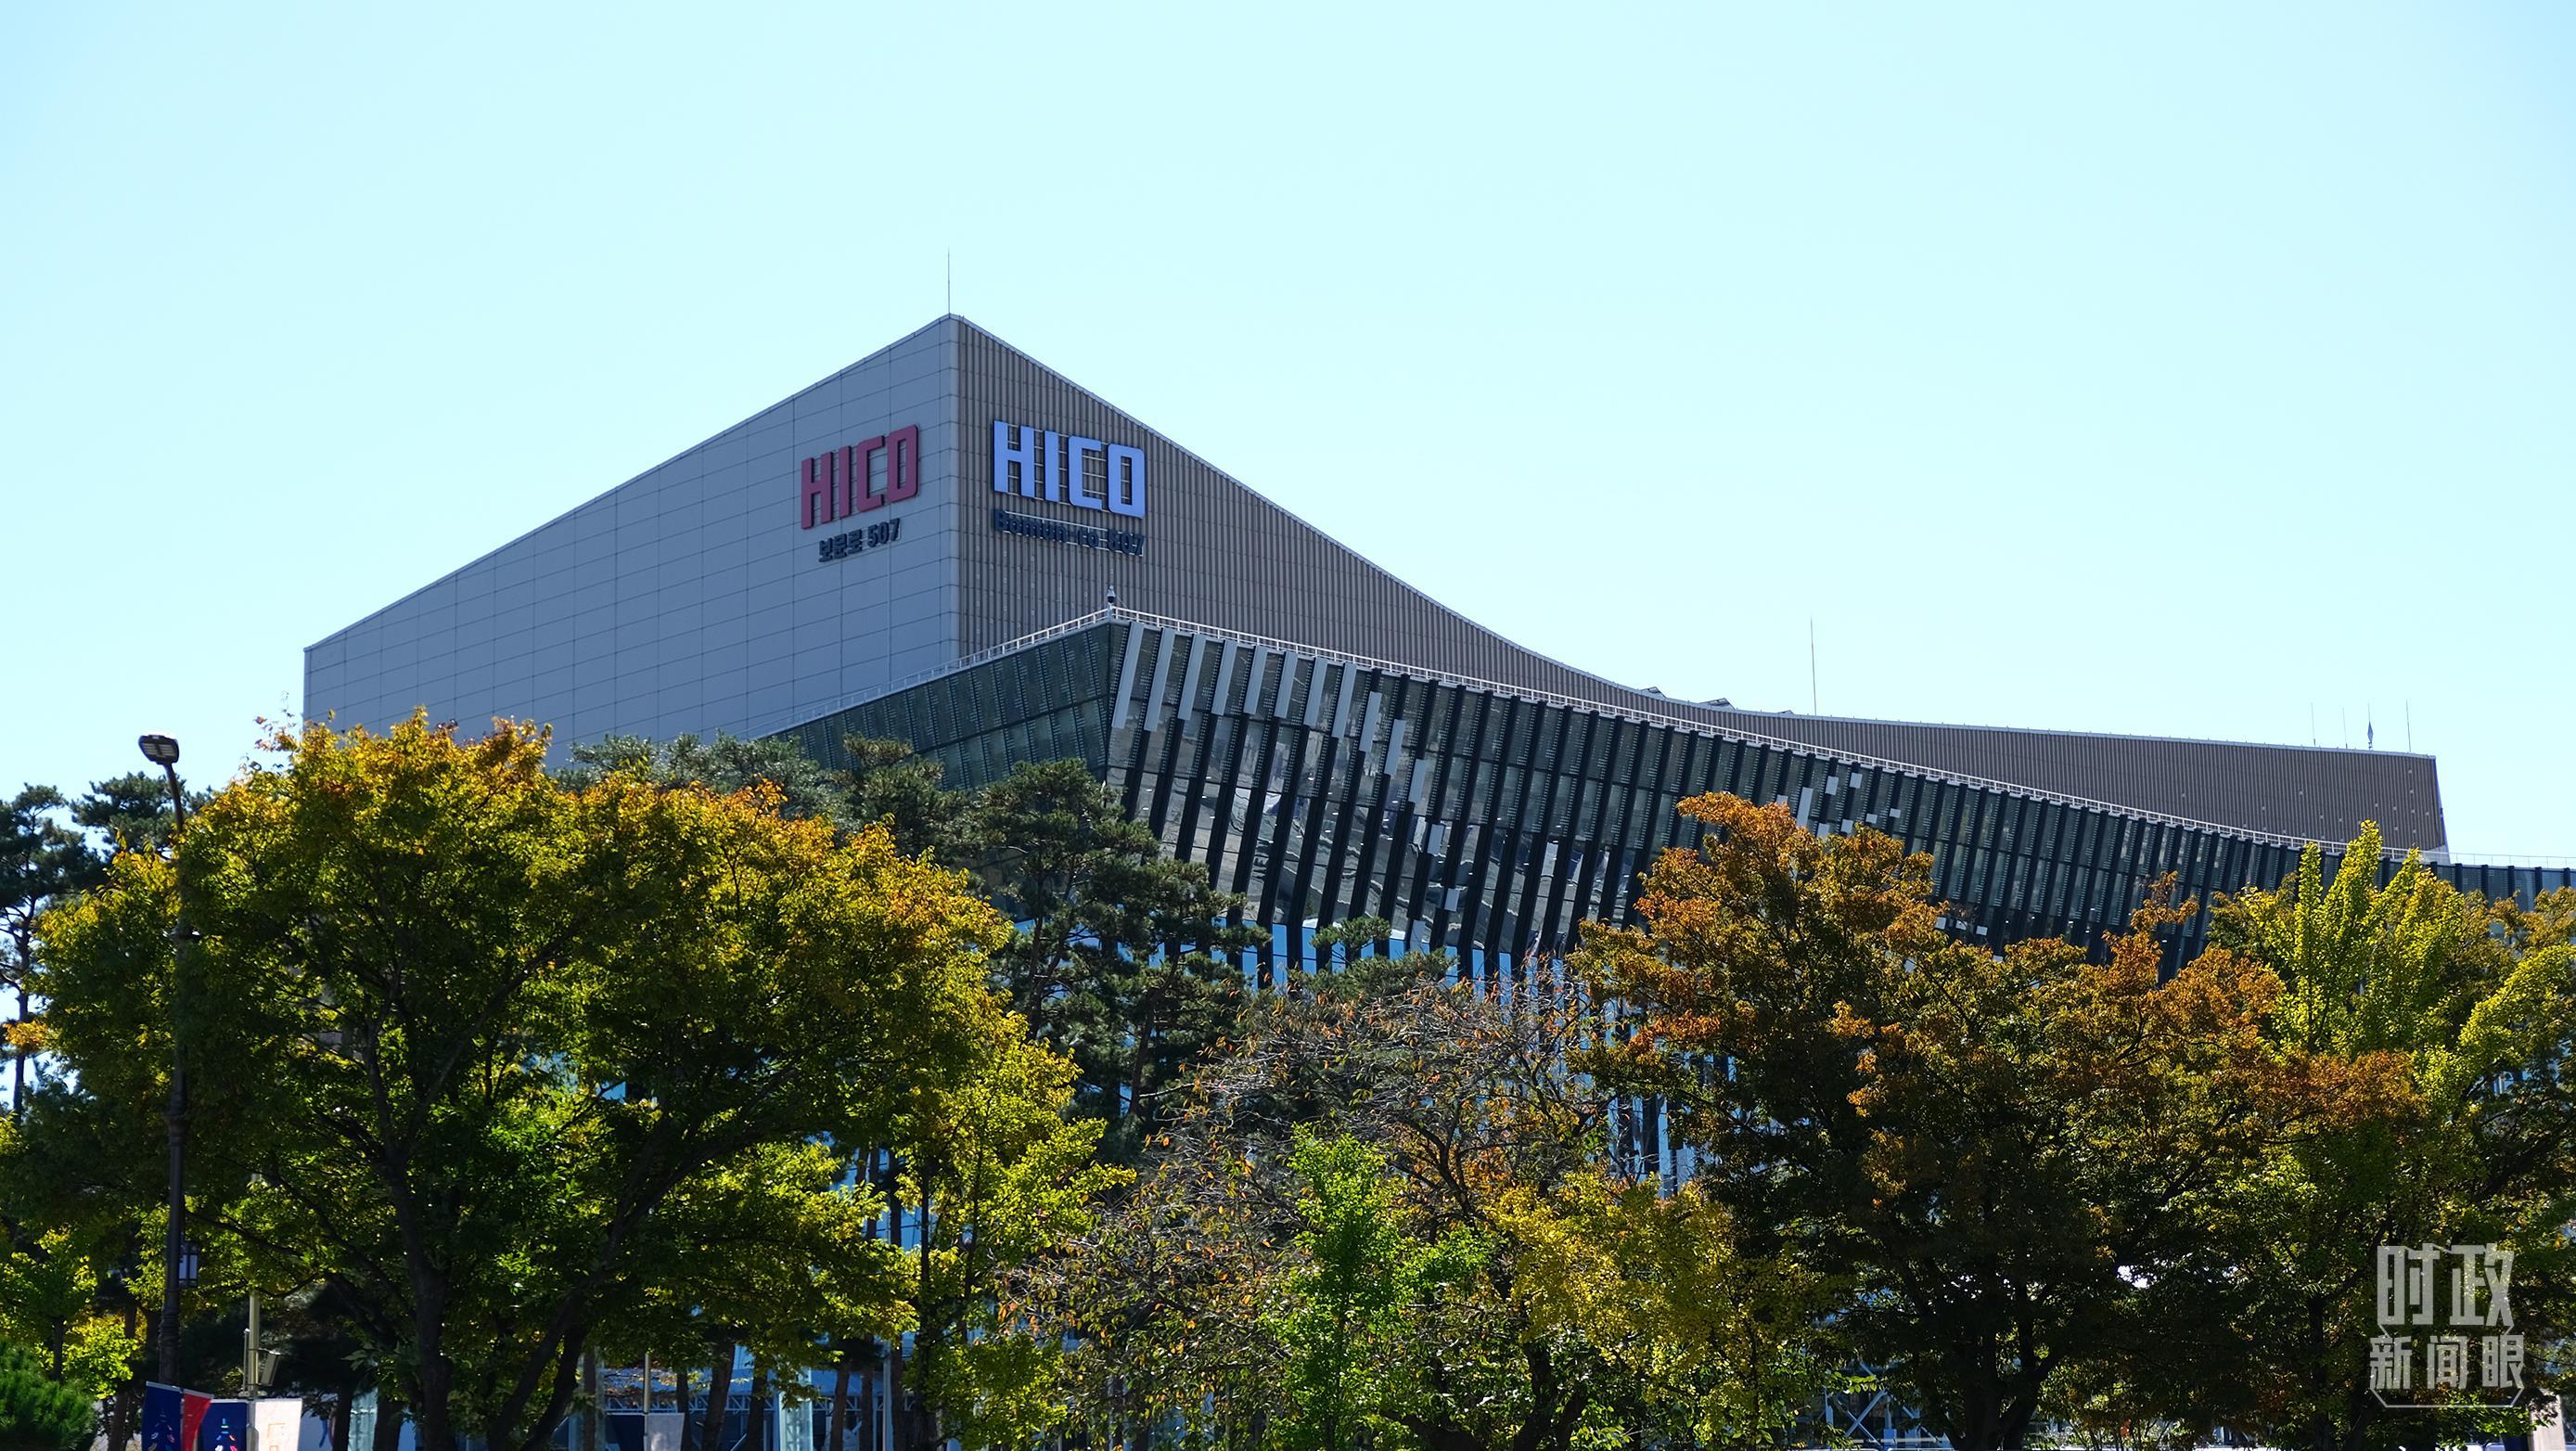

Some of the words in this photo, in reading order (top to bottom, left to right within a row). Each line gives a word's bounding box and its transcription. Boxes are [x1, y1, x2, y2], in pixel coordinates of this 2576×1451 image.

[801, 424, 919, 530] HICO
[993, 420, 1146, 519] HICO
[818, 529, 863, 563] 보문로
[867, 518, 900, 547] 507
[994, 508, 1099, 547] Bomun-ro
[1107, 527, 1145, 556] 507
